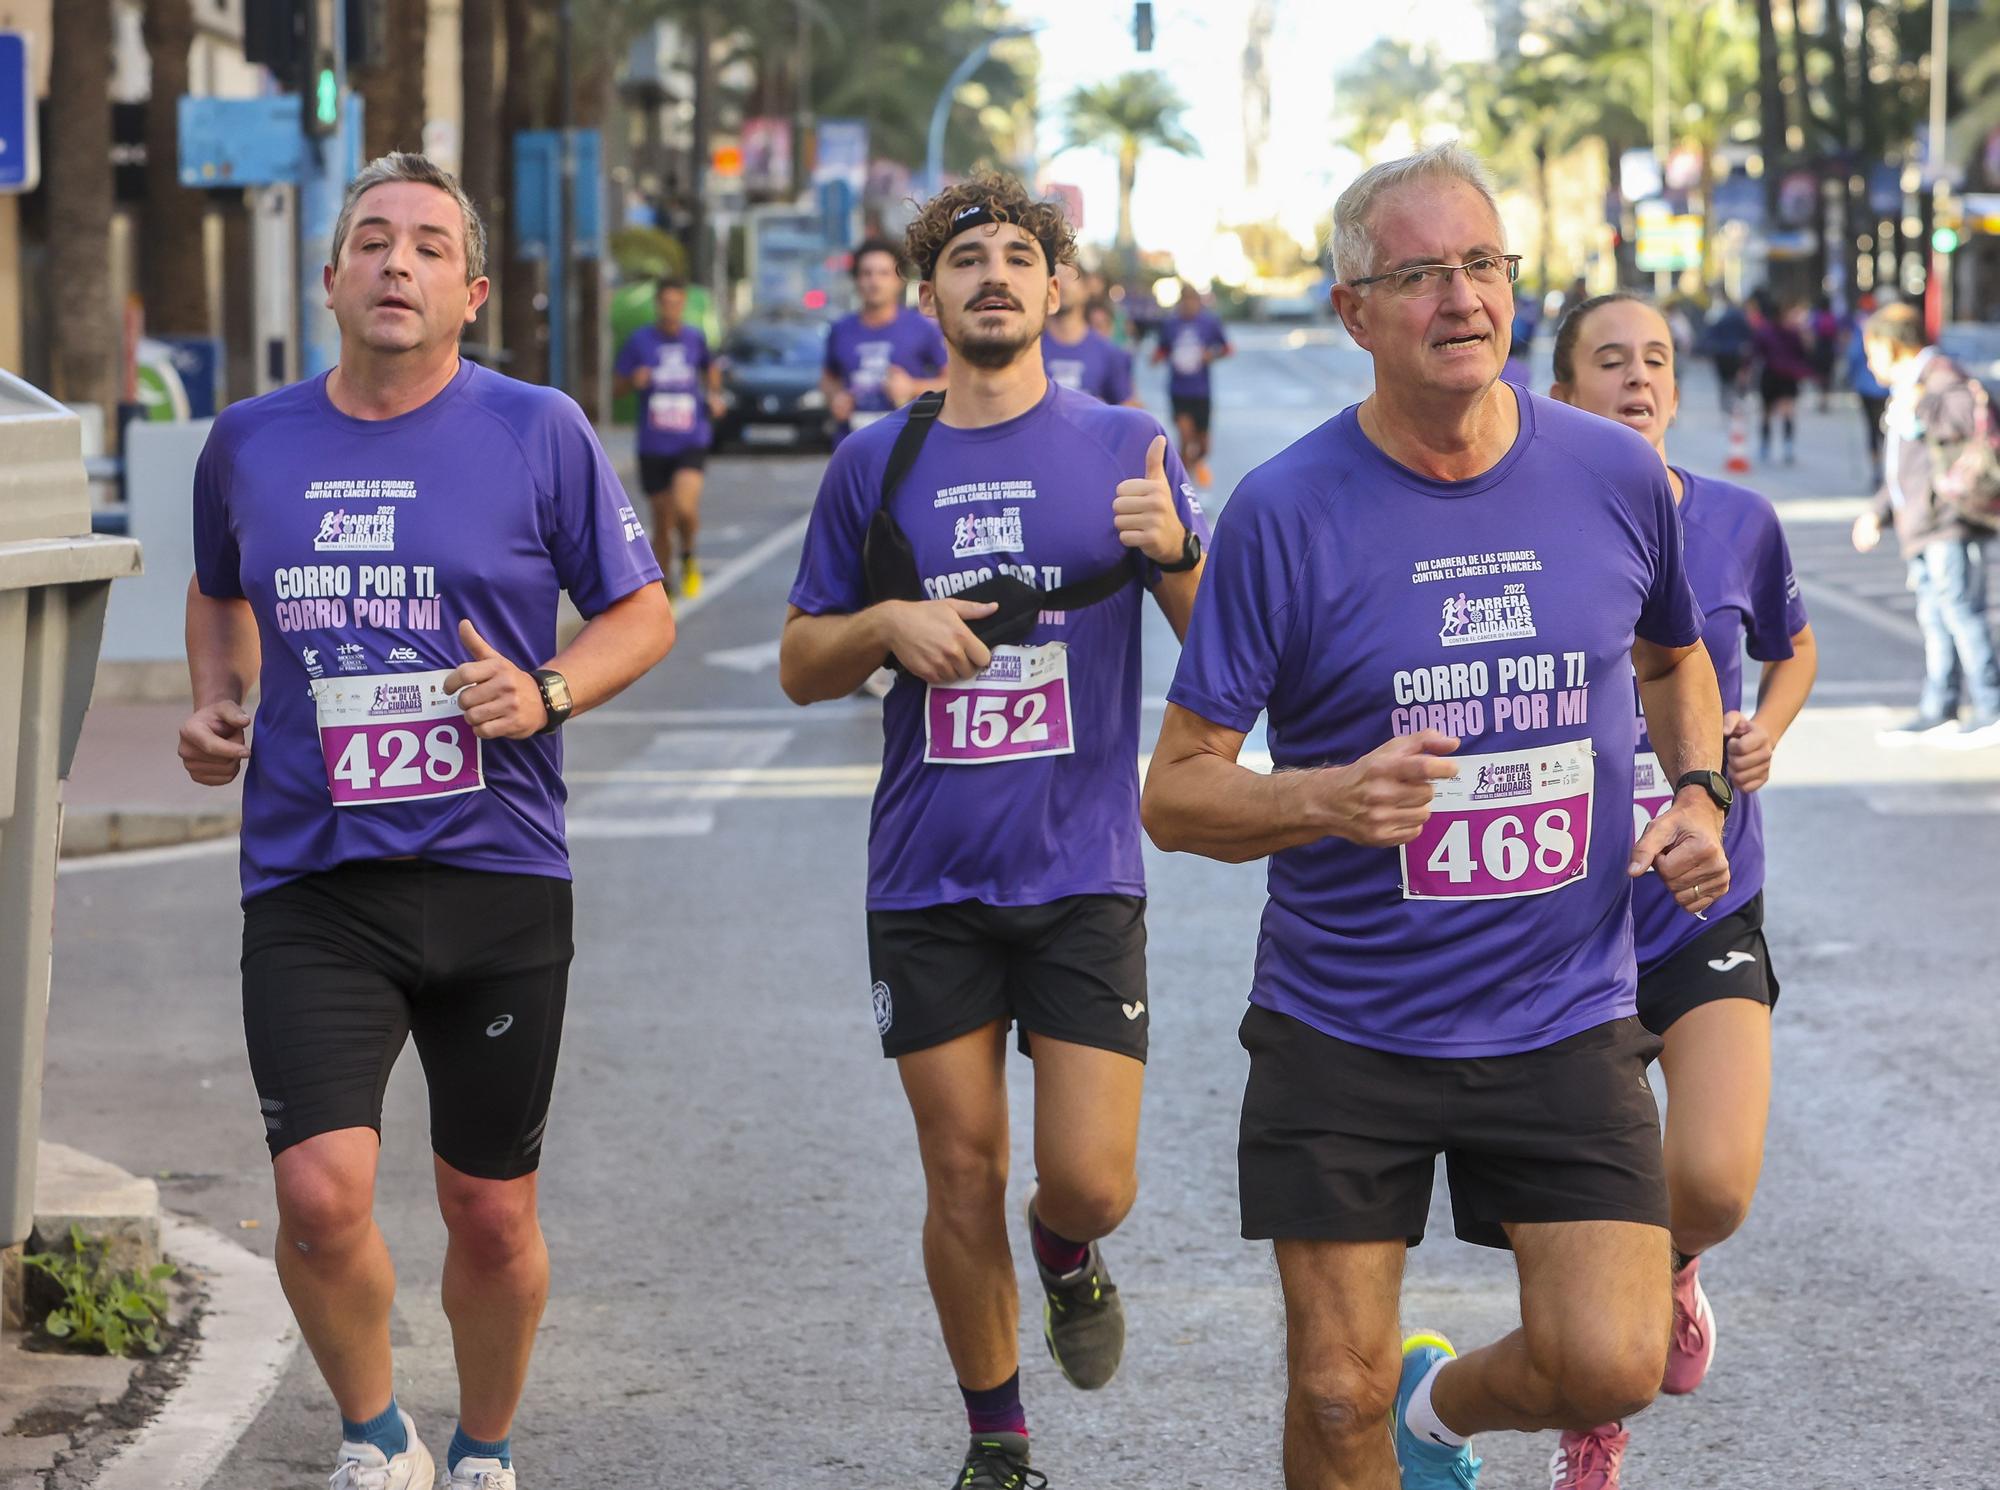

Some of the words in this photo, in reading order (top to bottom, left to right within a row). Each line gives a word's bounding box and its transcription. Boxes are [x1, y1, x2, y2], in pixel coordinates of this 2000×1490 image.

[310, 481, 323, 490] VIII
[323, 481, 355, 490] CARRERA
[356, 480, 366, 489] DE
[366, 480, 380, 489] LAS
[380, 480, 415, 489] CIUDADES
[948, 483, 977, 495] CARRERA
[977, 482, 987, 491] DE
[987, 482, 1000, 491] LAS
[1000, 481, 1032, 490] CIUDADES
[304, 490, 332, 499] CONTRA
[332, 490, 342, 498] EL
[371, 489, 380, 498] DE
[934, 496, 959, 508] CONTRA
[959, 495, 968, 504] EL
[993, 491, 1002, 500] DE
[377, 506, 395, 514] 2022
[1002, 507, 1020, 516] 2022
[342, 514, 395, 525] CARRERA
[974, 516, 1020, 529] CARRERA
[356, 525, 370, 534] DE
[373, 524, 395, 534] LAS
[987, 527, 1000, 537] DE
[1002, 525, 1022, 536] LAS
[339, 534, 394, 543] CIUDADES
[974, 534, 1023, 546] CIUDADES
[1415, 561, 1430, 572] VIII
[1430, 556, 1466, 570] CARRERA
[1468, 555, 1479, 565] DE
[1480, 553, 1496, 564] LAS
[1496, 550, 1536, 562] CIUDADES
[1412, 571, 1445, 584] CONTRA
[1445, 569, 1456, 579] EL
[1456, 564, 1489, 578] CÁNCER
[1489, 563, 1502, 574] DE
[1502, 560, 1543, 573] PÁNCREAS
[275, 565, 351, 599] CORRO
[359, 565, 406, 597] POR
[413, 566, 435, 598] TI
[1041, 566, 1062, 592] TI
[1503, 583, 1526, 595] 2022
[1466, 594, 1529, 612] CARRERA
[275, 599, 347, 632] CORRO
[353, 598, 401, 629] POR
[408, 593, 441, 630] MÍ
[1484, 608, 1504, 622] DE
[1505, 605, 1532, 619] LAS
[1467, 617, 1534, 635] CIUDADES
[1393, 660, 1489, 706] CORRO
[1498, 654, 1555, 694] POR
[1563, 651, 1586, 688] TI
[388, 685, 420, 694] CARRERA
[399, 693, 407, 701] DE
[409, 692, 421, 700] LAS
[388, 700, 422, 710] CIUDADES
[1391, 699, 1485, 738] CORRO
[1493, 693, 1549, 733] POR
[1557, 681, 1590, 727] MÍ
[946, 693, 1049, 748] 152
[334, 725, 464, 790] 428
[1494, 763, 1529, 776] CARRERA
[1506, 773, 1516, 782] DE
[1517, 771, 1531, 781] LAS
[1494, 780, 1532, 793] CIUDADES
[1428, 808, 1575, 883] 468
